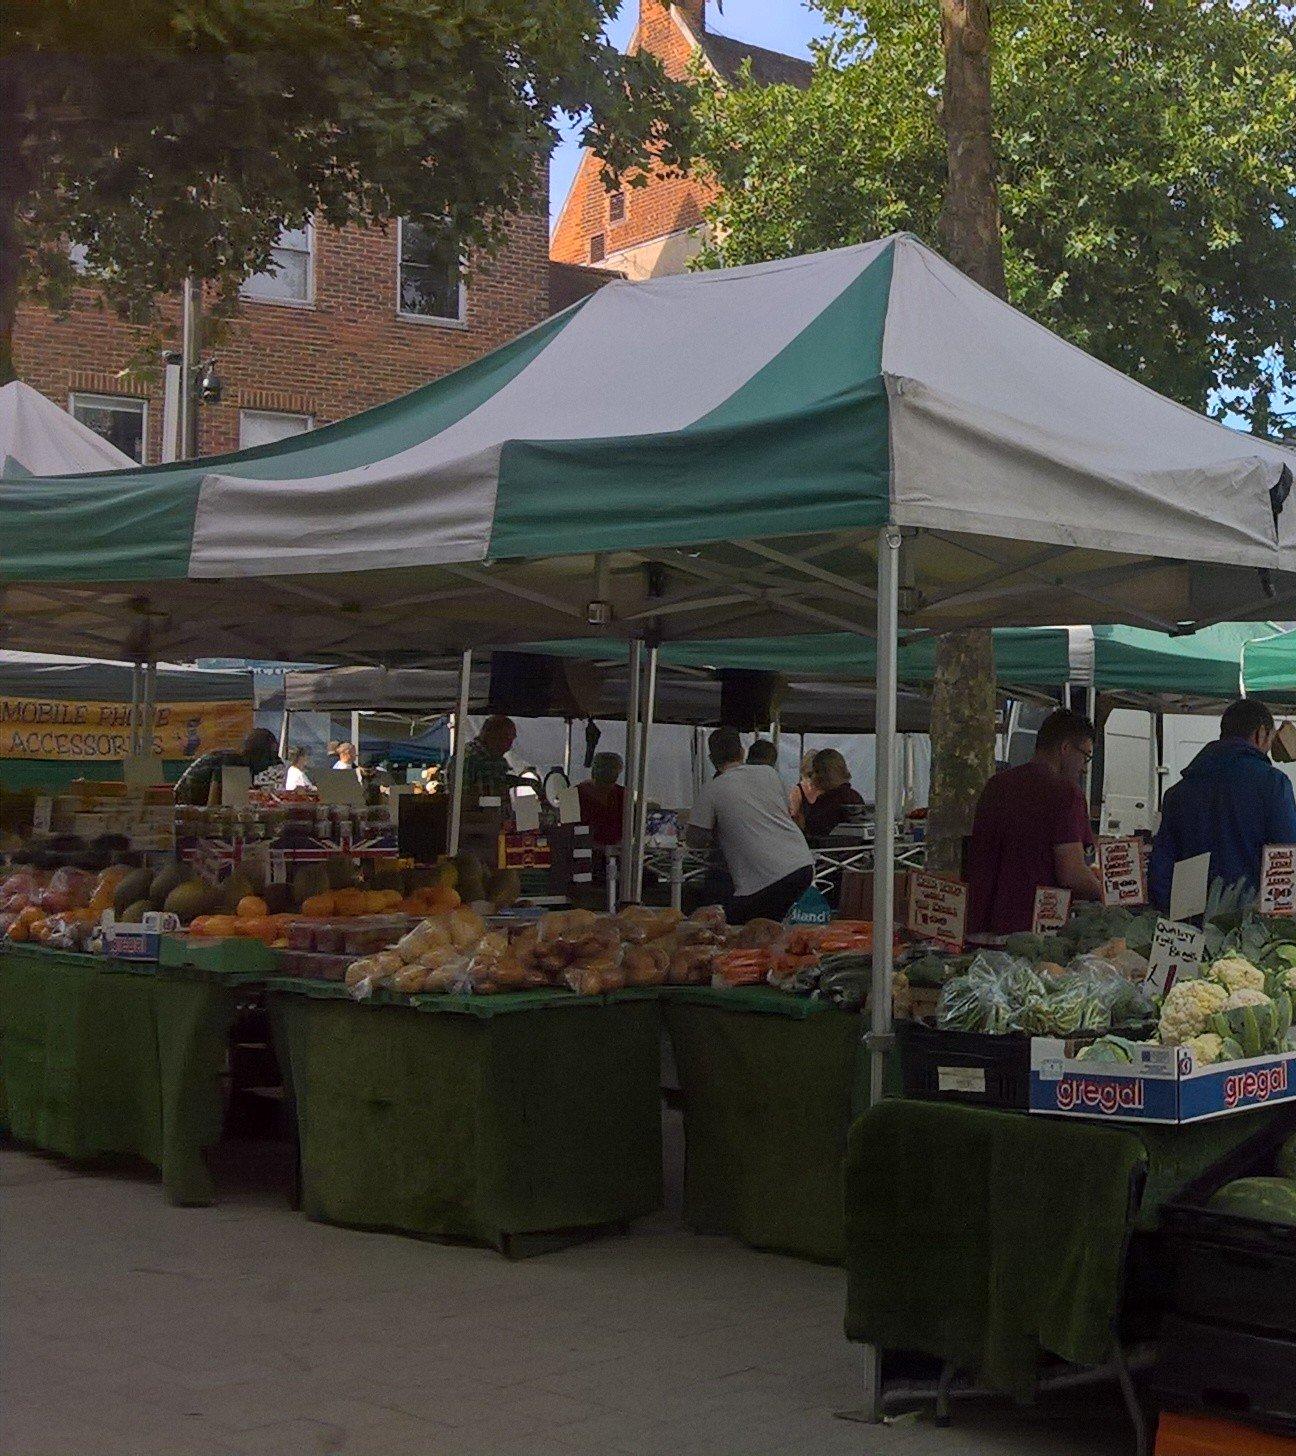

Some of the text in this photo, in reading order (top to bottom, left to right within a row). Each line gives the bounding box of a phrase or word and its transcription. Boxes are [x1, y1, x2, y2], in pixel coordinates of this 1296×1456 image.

[0, 701, 87, 724] MOBILE
[10, 731, 163, 755] ACCESSORIS
[1056, 1077, 1144, 1114] gregal
[1224, 1062, 1288, 1108] gregal
